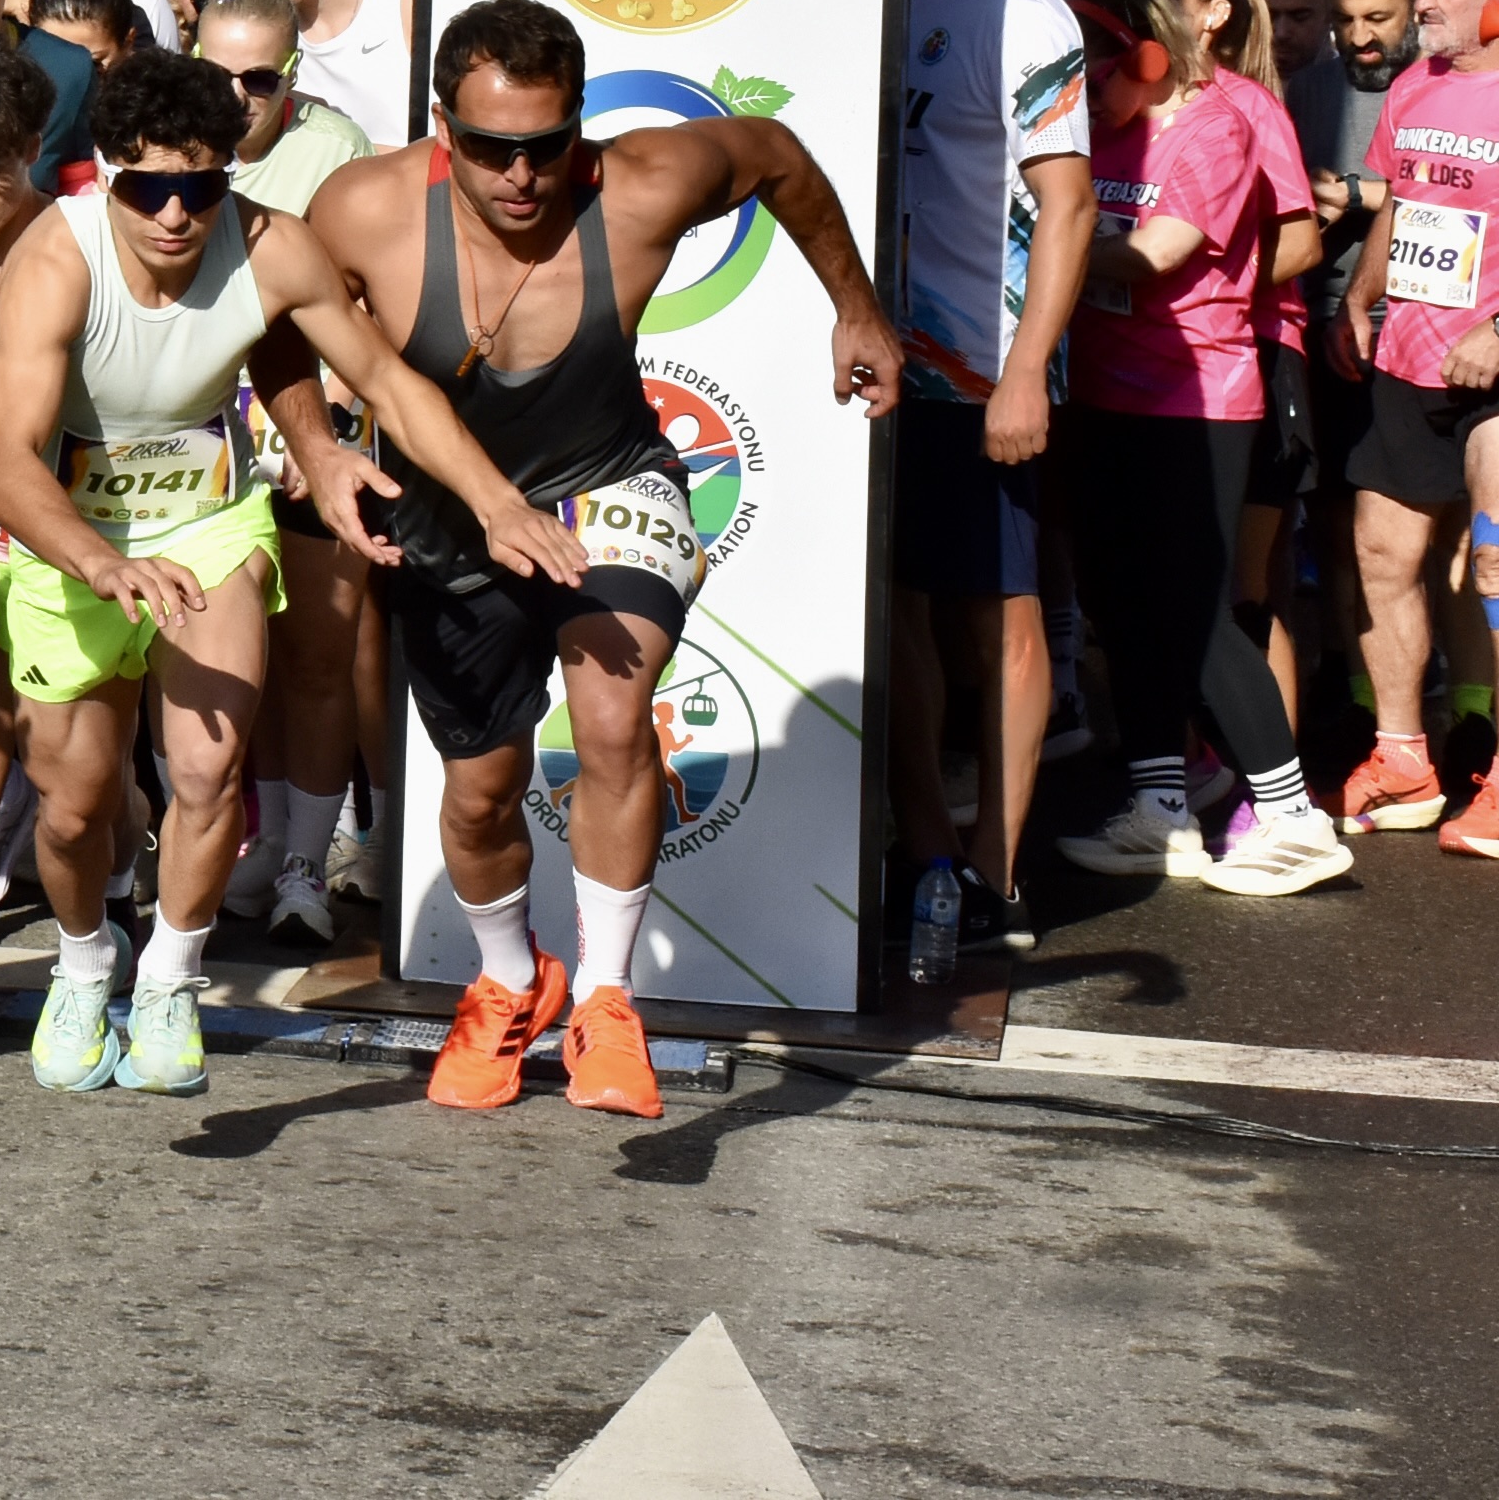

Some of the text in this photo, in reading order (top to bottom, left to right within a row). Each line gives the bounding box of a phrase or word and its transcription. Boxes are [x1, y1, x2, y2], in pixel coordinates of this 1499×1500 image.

[1389, 238, 1459, 272] 21168
[663, 359, 765, 473] FEDERASYONU
[86, 468, 206, 497] 10141
[584, 498, 695, 561] 10129
